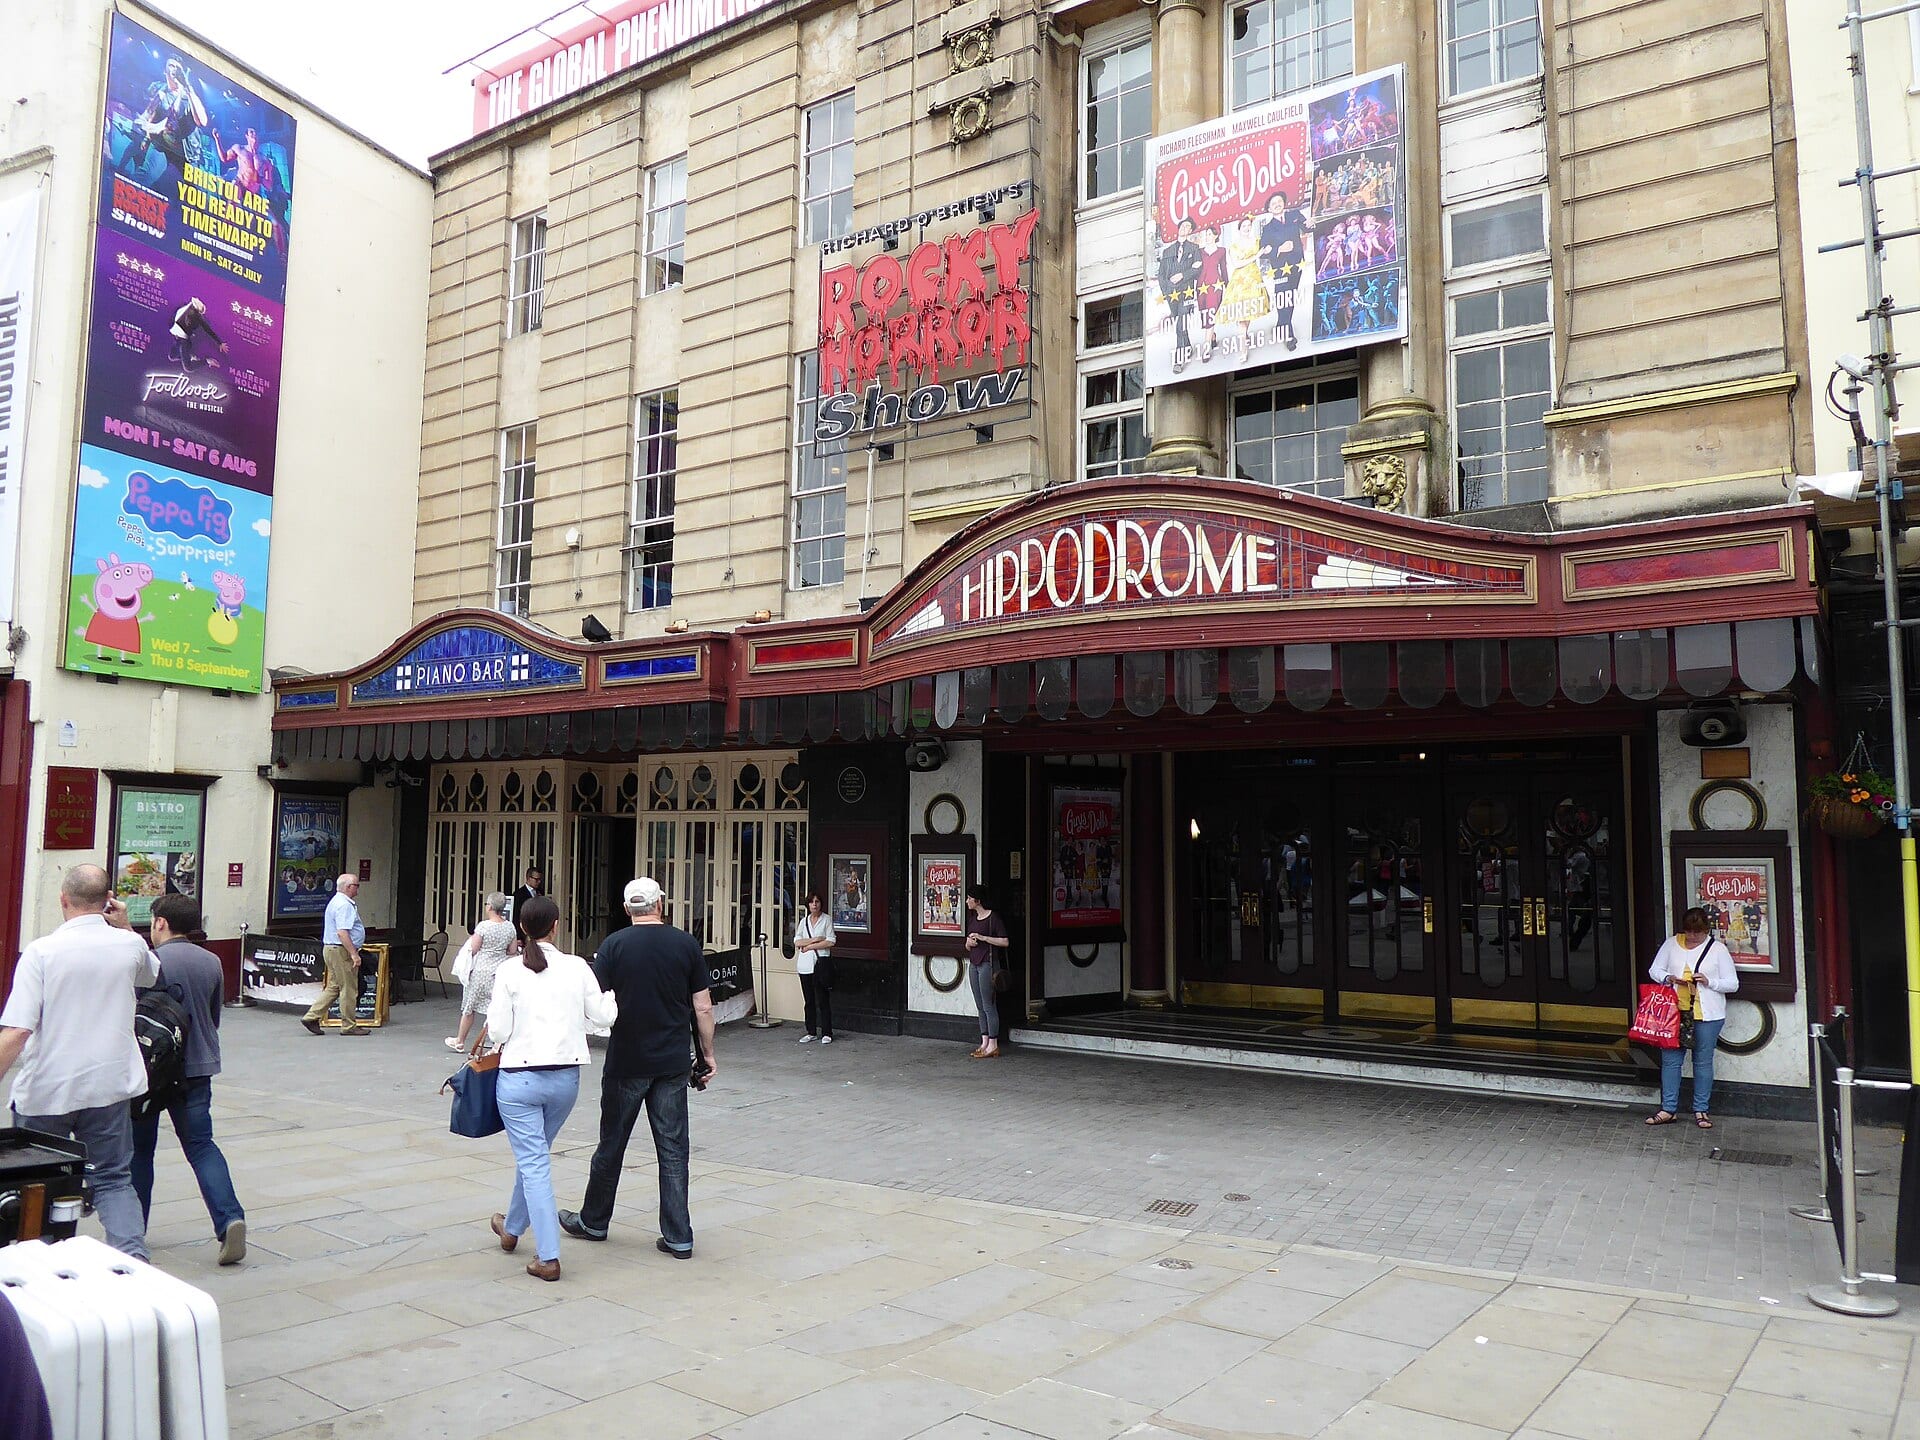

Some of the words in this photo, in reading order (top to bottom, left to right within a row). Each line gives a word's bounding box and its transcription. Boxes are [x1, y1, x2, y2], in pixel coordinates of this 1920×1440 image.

[488, 68, 523, 129] THE
[528, 30, 609, 109] GLOBAL
[614, 0, 780, 69] PHENOM
[1159, 138, 1187, 157] RICHARD
[1187, 126, 1226, 148] FLEESHMAN
[1232, 114, 1266, 134] MAXWELL
[1267, 103, 1304, 124] CAULFIELD
[183, 162, 241, 204] BRISTOL
[242, 190, 269, 217] ARE
[1169, 164, 1228, 226] Guys
[1221, 182, 1238, 204] and
[1232, 140, 1296, 207] Dolls
[111, 207, 165, 239] Show
[176, 181, 207, 210] YOU
[208, 197, 254, 232] READY
[255, 215, 273, 239] TO
[820, 216, 912, 256] RICHARD
[915, 183, 1024, 228] O'BRIEN'S
[181, 205, 266, 256] TIMEWARP?
[181, 238, 202, 258] MON
[202, 247, 212, 261] 18
[216, 252, 232, 270] SAT
[232, 260, 243, 276] 23
[242, 265, 262, 284] JULY
[821, 208, 1040, 338] ROCKY
[116, 273, 145, 289] FEELING
[147, 285, 162, 297] LIKE
[117, 287, 131, 298] THE
[125, 283, 139, 294] CAN
[1158, 315, 1179, 336] JOY
[1182, 312, 1193, 332] IN
[1221, 296, 1265, 321] PUREST
[110, 321, 151, 343] GARETH
[113, 331, 146, 350] GATES
[818, 287, 1032, 396] HORROR
[1170, 346, 1192, 366] TUE
[1194, 341, 1210, 361] 12
[1222, 334, 1247, 355] SAT
[1248, 329, 1265, 350] 16
[1268, 324, 1293, 345] JUL
[142, 372, 228, 402] Footloose
[229, 367, 270, 388] MAUREEN
[234, 376, 265, 394] NOLAN
[186, 401, 198, 410] THE
[199, 403, 225, 414] MUSICAL
[814, 369, 1022, 442] Show
[104, 416, 149, 445] MON
[151, 430, 160, 448] 1
[172, 437, 207, 461] SAT
[208, 450, 220, 466] 6
[222, 453, 257, 477] AUG
[129, 474, 196, 528] Peppa
[198, 494, 230, 541] Pig
[117, 516, 144, 535] Peppa
[155, 537, 231, 567] Surprise!
[962, 519, 1278, 621] HIPPODROME
[151, 637, 180, 654] Wed
[183, 643, 190, 655] 7
[151, 653, 174, 668] Thu
[176, 655, 184, 669] 8
[187, 658, 251, 679] September
[416, 663, 465, 687] PIANO
[471, 659, 504, 682] BAR
[57, 793, 86, 804] BOX
[136, 801, 185, 814] BISTRO
[49, 807, 93, 820] OFFICE
[283, 812, 310, 836] SOUND
[1066, 808, 1087, 835] Guys
[125, 839, 131, 848] 2
[131, 840, 168, 848] COURSES
[168, 840, 191, 848] £12.95
[1707, 876, 1731, 896] Guys
[1731, 877, 1757, 897] Dolls
[276, 950, 300, 964] PIANO
[300, 953, 316, 966] BAR
[721, 965, 738, 979] BAR
[1656, 1030, 1672, 1039] LESS
